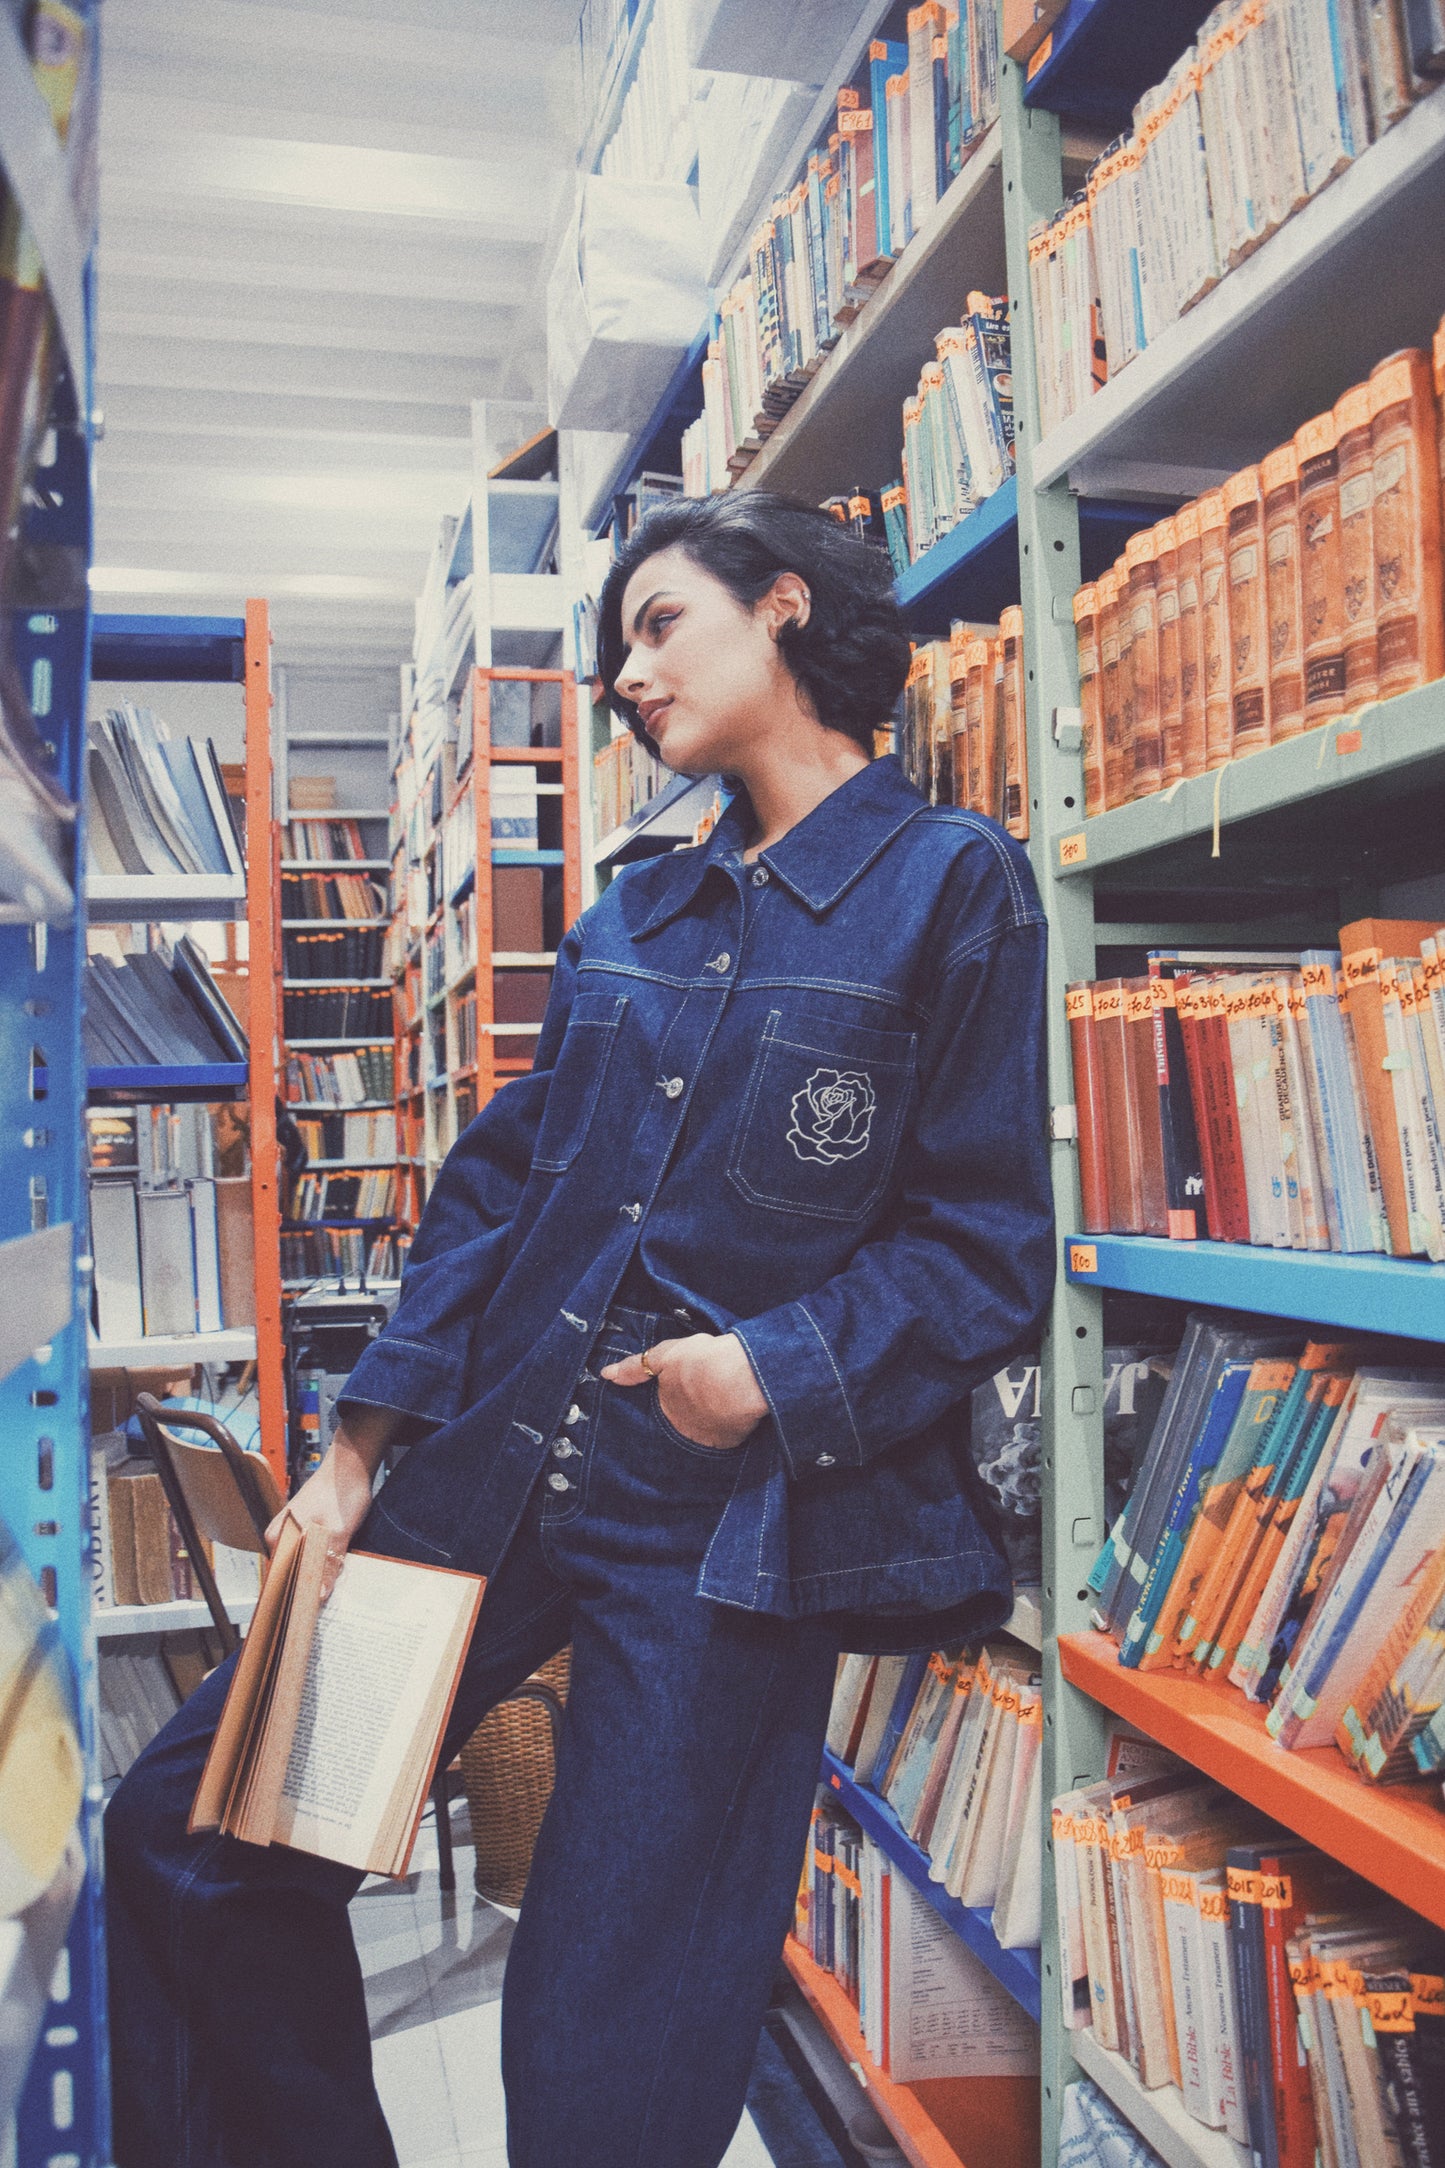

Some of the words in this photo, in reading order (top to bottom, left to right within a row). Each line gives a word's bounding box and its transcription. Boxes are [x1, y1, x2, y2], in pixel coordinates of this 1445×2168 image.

[1155, 1019, 1166, 1074] Universal
[1181, 1936, 1191, 1982] Testament
[1213, 1941, 1223, 1989] Testament
[1185, 1985, 1194, 2017] Ancien
[1187, 2025, 1200, 2066] Bible
[1221, 2043, 1235, 2082] Bible
[1394, 2039, 1415, 2084] sables
[1190, 2068, 1201, 2089] La
[1225, 2083, 1237, 2108] La
